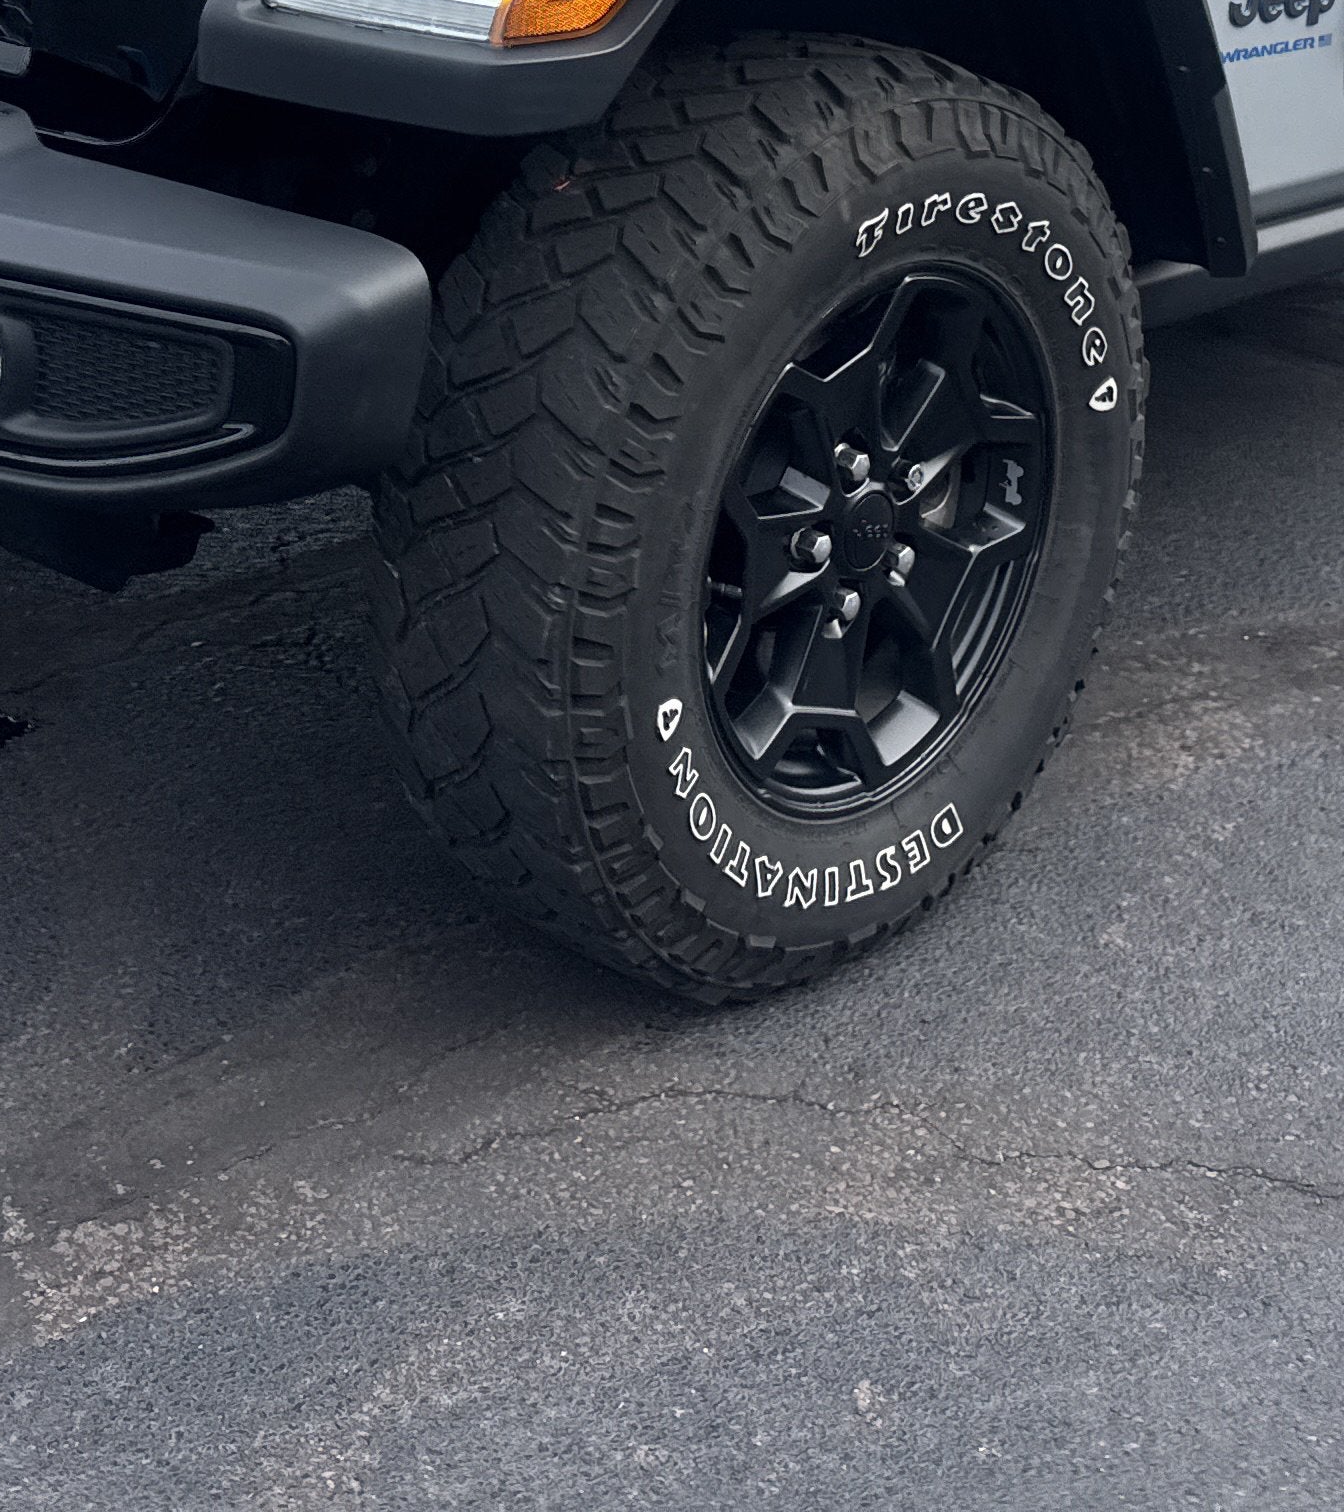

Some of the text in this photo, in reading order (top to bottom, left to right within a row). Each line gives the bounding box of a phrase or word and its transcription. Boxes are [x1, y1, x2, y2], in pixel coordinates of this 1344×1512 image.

[1221, 37, 1315, 65] WRANGLER
[856, 192, 1108, 367] Firestone
[668, 746, 964, 910] DESTINATION
